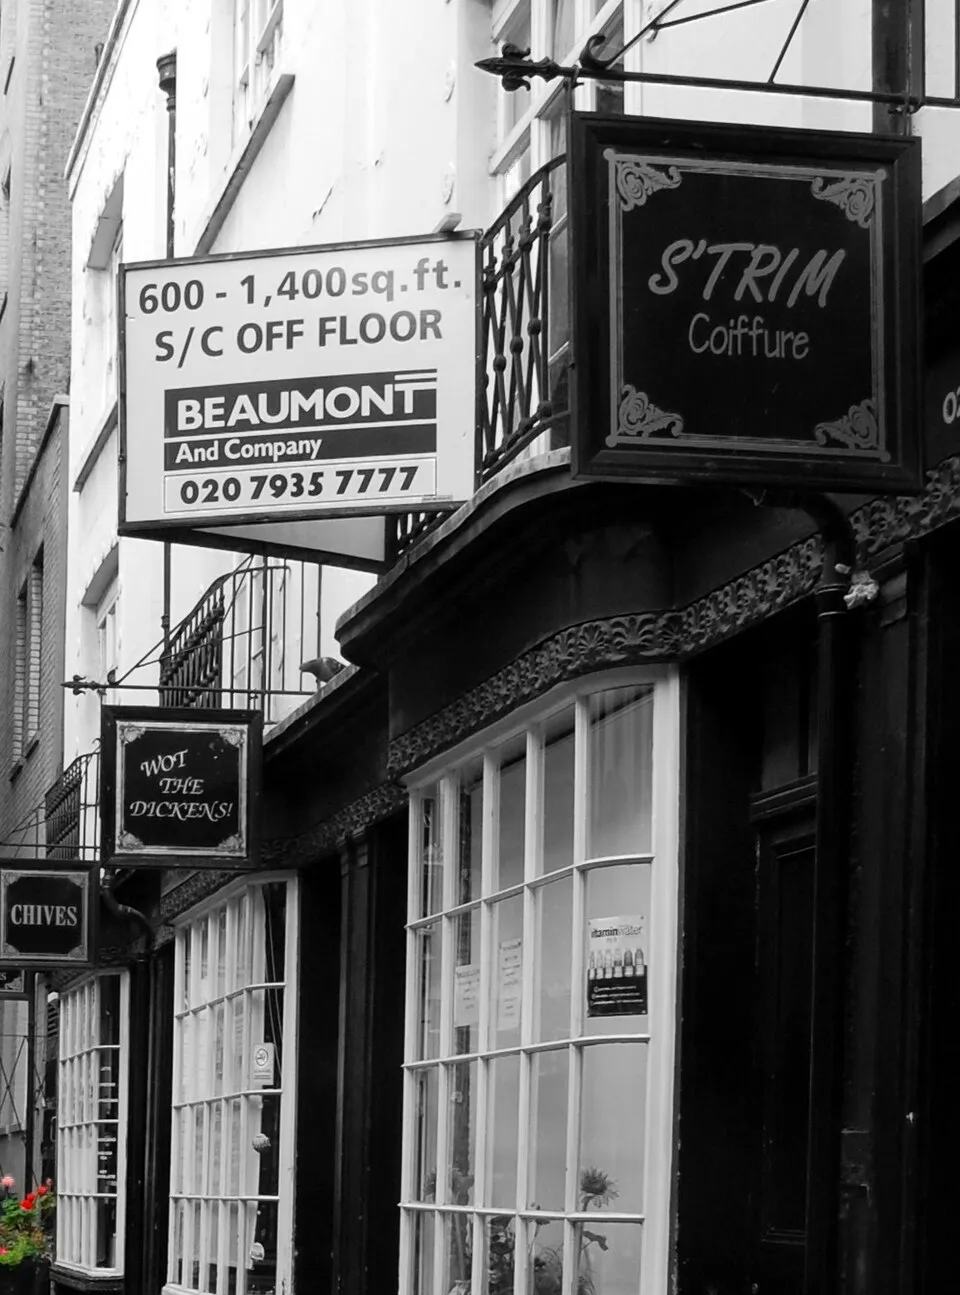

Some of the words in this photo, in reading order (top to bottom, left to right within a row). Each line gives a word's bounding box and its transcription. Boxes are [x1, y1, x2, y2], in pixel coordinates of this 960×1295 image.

[648, 239, 846, 308] S'TRIM
[139, 279, 204, 314] 600
[155, 326, 224, 368] S/C
[237, 319, 304, 353] OFF
[318, 309, 443, 347] FLOOR
[688, 313, 809, 359] Coiffure
[177, 377, 437, 431] BEAUMONT
[175, 440, 219, 464] And
[224, 437, 322, 462] Company
[180, 477, 241, 504] 020
[250, 471, 324, 500] 7935
[336, 466, 419, 495] 7777
[140, 749, 188, 777] WOT
[159, 777, 204, 795] THE
[129, 800, 233, 822] DICKENS!
[10, 904, 77, 926] CHIVES
